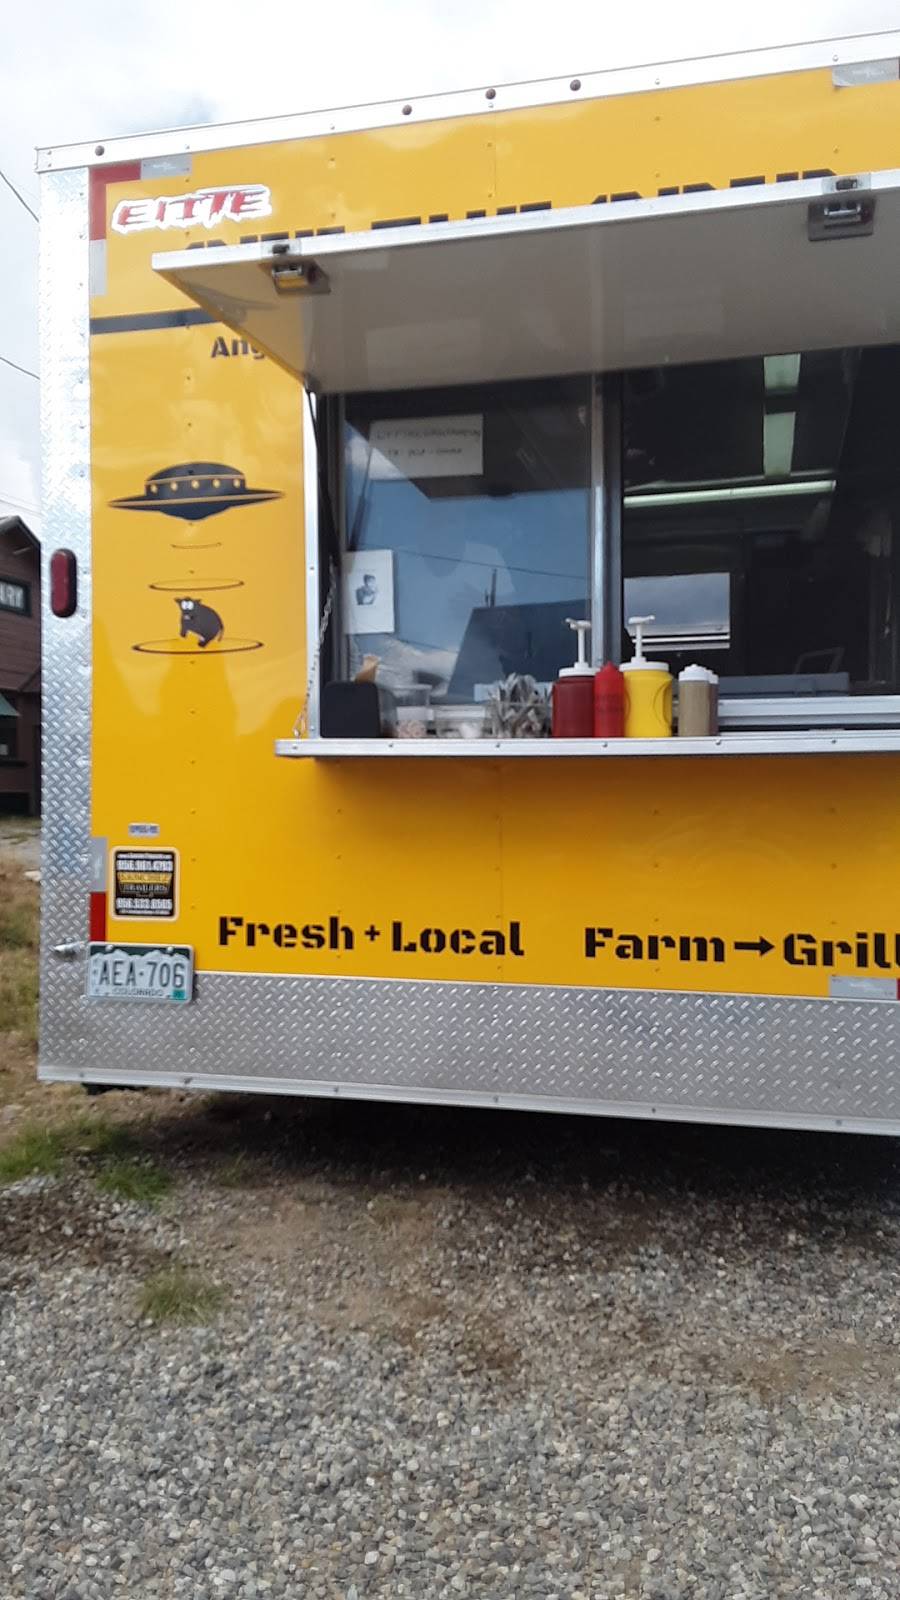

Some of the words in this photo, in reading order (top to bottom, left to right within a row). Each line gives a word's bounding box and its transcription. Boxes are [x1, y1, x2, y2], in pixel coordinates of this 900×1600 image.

[218, 915, 355, 951] Fresh
[391, 920, 525, 957] Local
[584, 926, 726, 963] Farm
